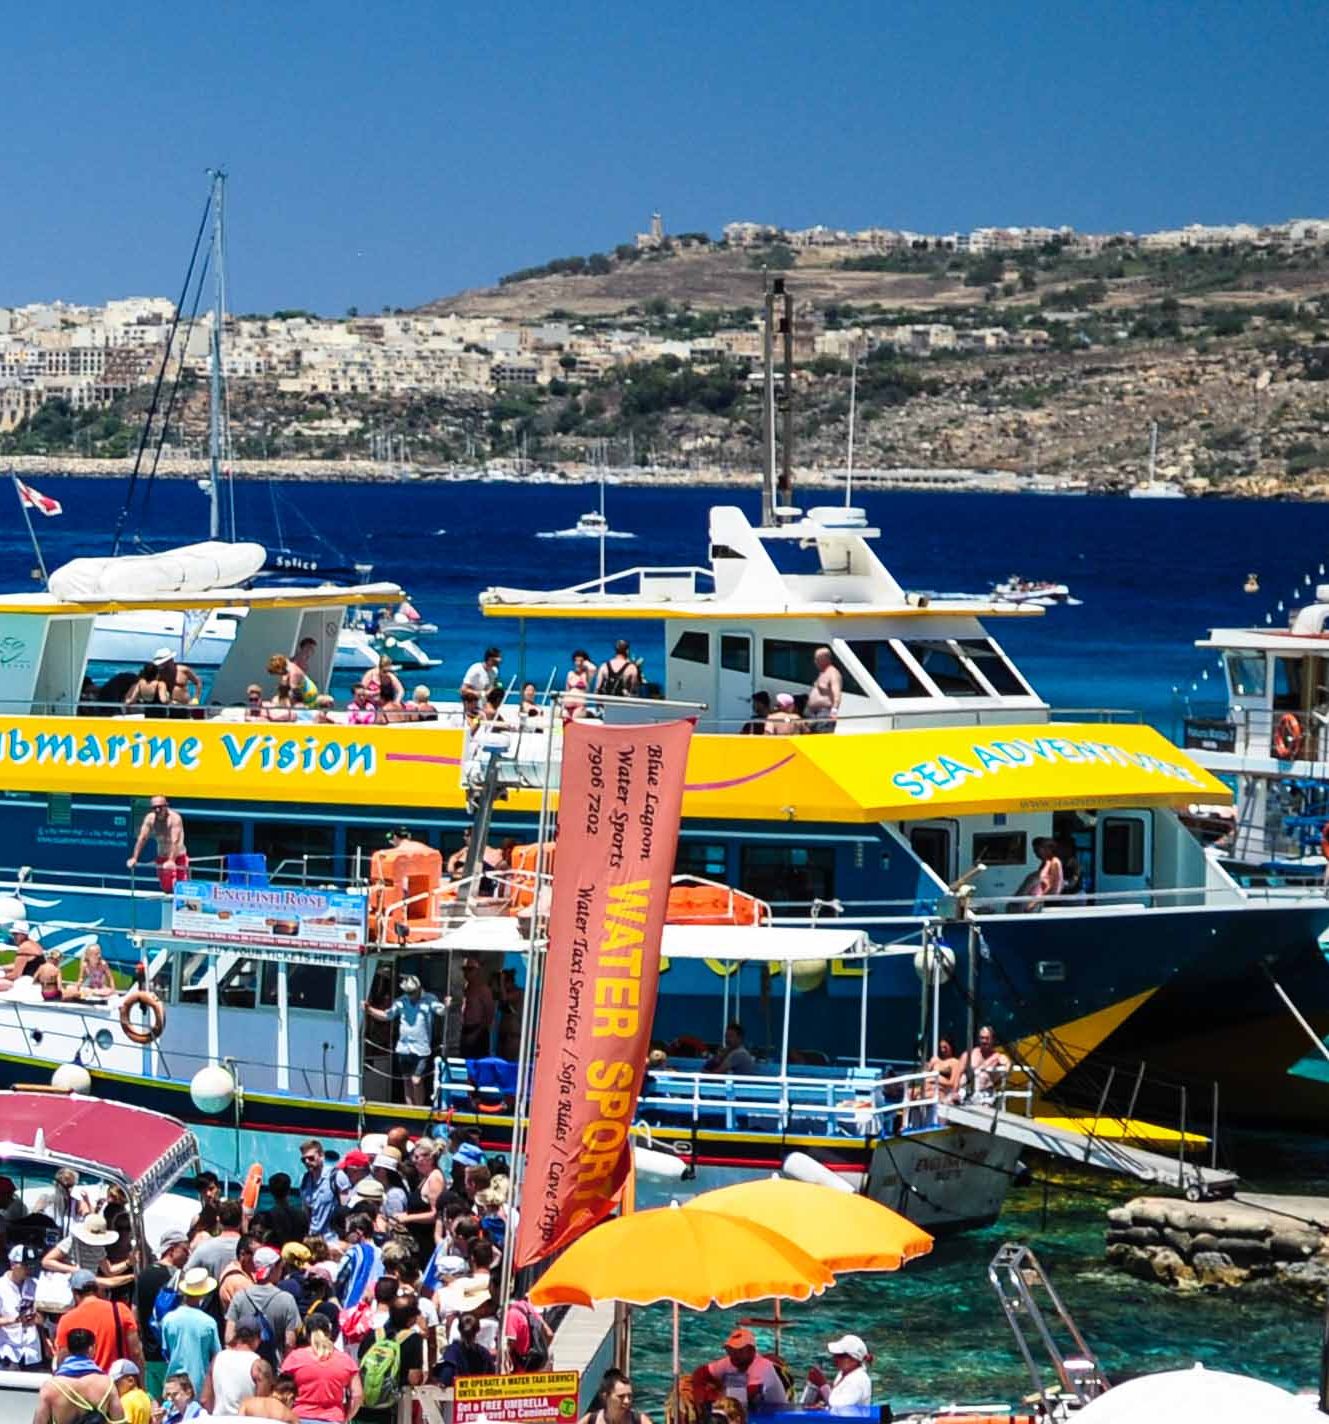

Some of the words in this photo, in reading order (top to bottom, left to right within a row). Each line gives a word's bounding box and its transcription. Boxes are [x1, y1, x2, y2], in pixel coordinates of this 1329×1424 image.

[221, 732, 377, 776] Vision
[588, 743, 603, 788] 7906
[616, 746, 635, 806] Water
[647, 744, 663, 786] Blue
[892, 755, 978, 799] SEA
[585, 792, 602, 836] 7202
[640, 792, 661, 860] Lagoon
[609, 807, 629, 869] Sports
[212, 885, 283, 903] ENGLISH
[284, 887, 328, 908] ROSE
[575, 885, 595, 935] Water
[570, 939, 590, 975] Taxi
[591, 879, 651, 1038] WATER
[565, 976, 583, 1041] Services
[557, 1062, 576, 1093] Sofa
[551, 1096, 574, 1143] Rides
[546, 1162, 564, 1200] Cave
[458, 1389, 477, 1398] UNTIL
[470, 1378, 500, 1388] OPERATE
[508, 1376, 531, 1385] WATER
[532, 1375, 547, 1384] TAXI
[548, 1374, 575, 1383] SERVICE
[457, 1402, 472, 1412] Get
[481, 1400, 502, 1411] FREE
[503, 1397, 549, 1410] UMBRELLA
[507, 1409, 516, 1419] to
[517, 1406, 559, 1418] Cominotto
